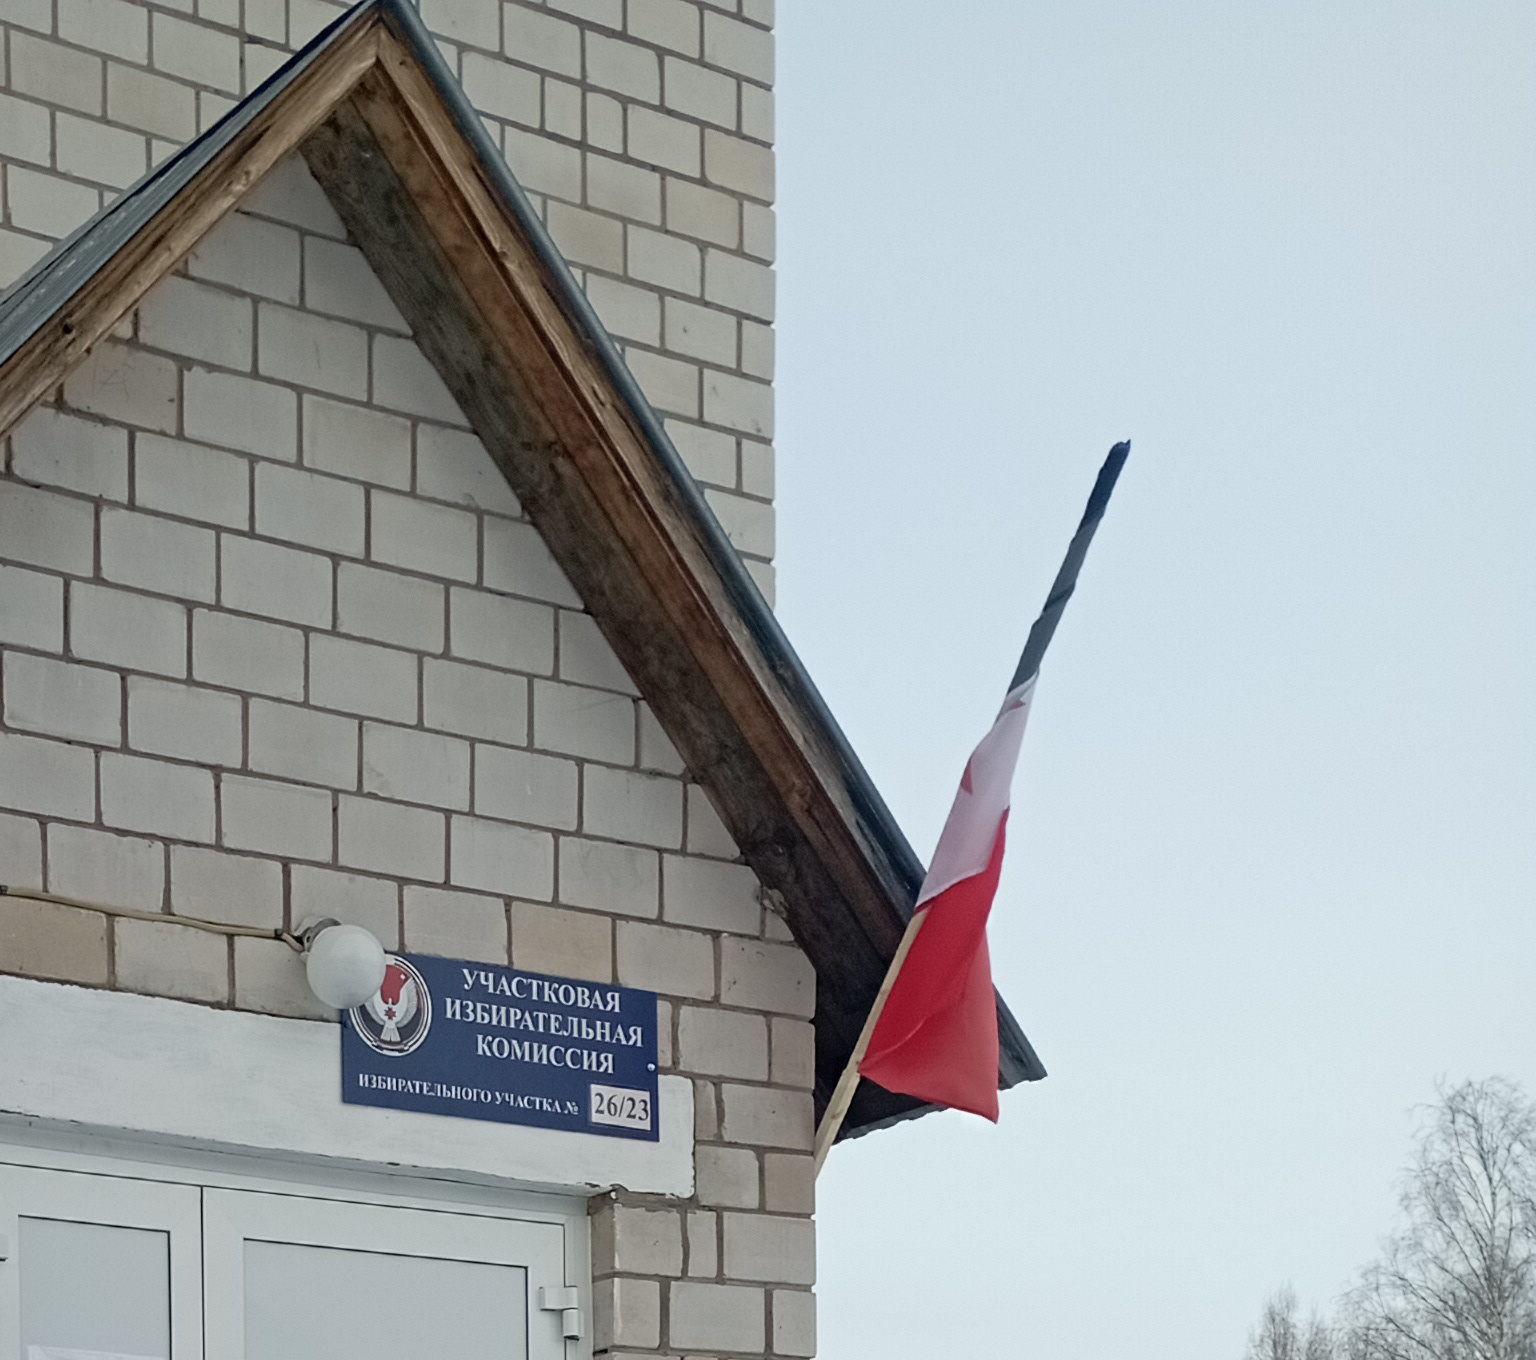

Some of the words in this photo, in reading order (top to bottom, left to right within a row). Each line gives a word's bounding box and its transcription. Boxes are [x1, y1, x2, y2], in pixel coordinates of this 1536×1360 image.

[462, 968, 620, 1013] УЧАСТКОВАЯ
[445, 998, 644, 1047] ИЗБИРАТЕЛЬНАЯ
[477, 1034, 614, 1074] КОМИССИЯ
[359, 1073, 492, 1104] ИЗБИРАТЕЛЬНОГО
[495, 1091, 561, 1114] УЧАСТКА
[594, 1092, 650, 1122] 26/23
